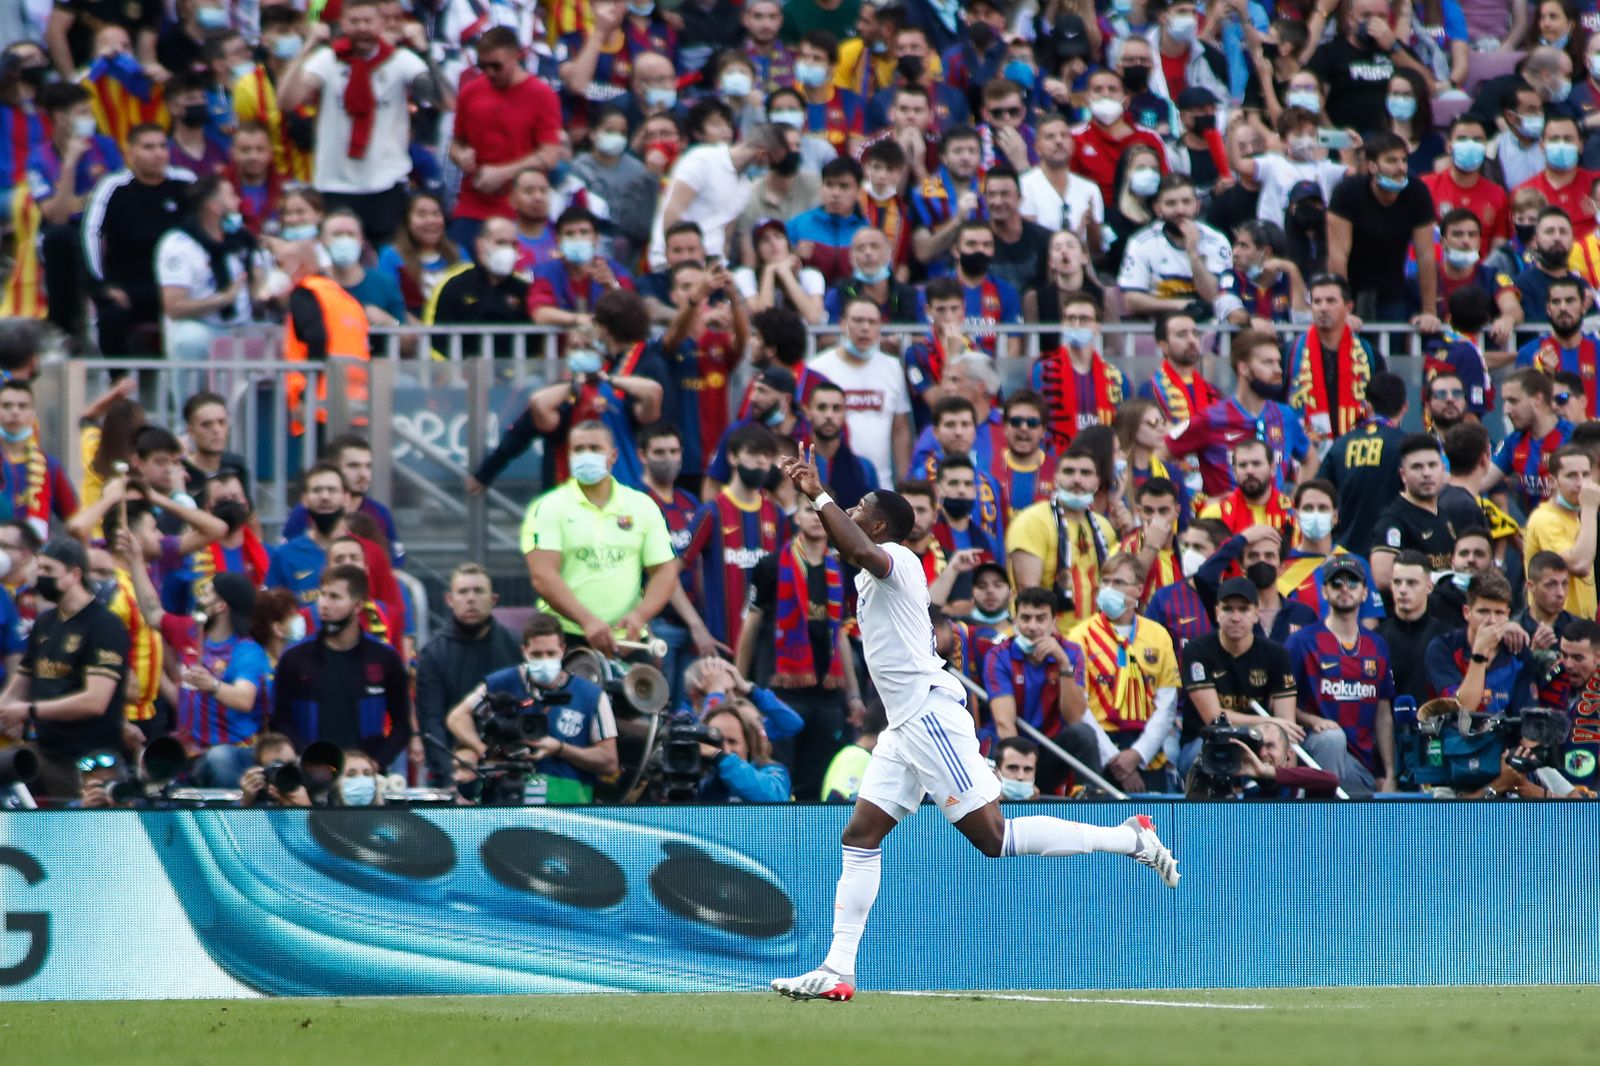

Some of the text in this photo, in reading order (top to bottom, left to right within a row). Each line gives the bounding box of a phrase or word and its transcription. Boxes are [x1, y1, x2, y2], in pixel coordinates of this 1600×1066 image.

[1345, 438, 1384, 468] FCB
[576, 547, 626, 562] QATAR
[1321, 678, 1377, 700] Rakuten
